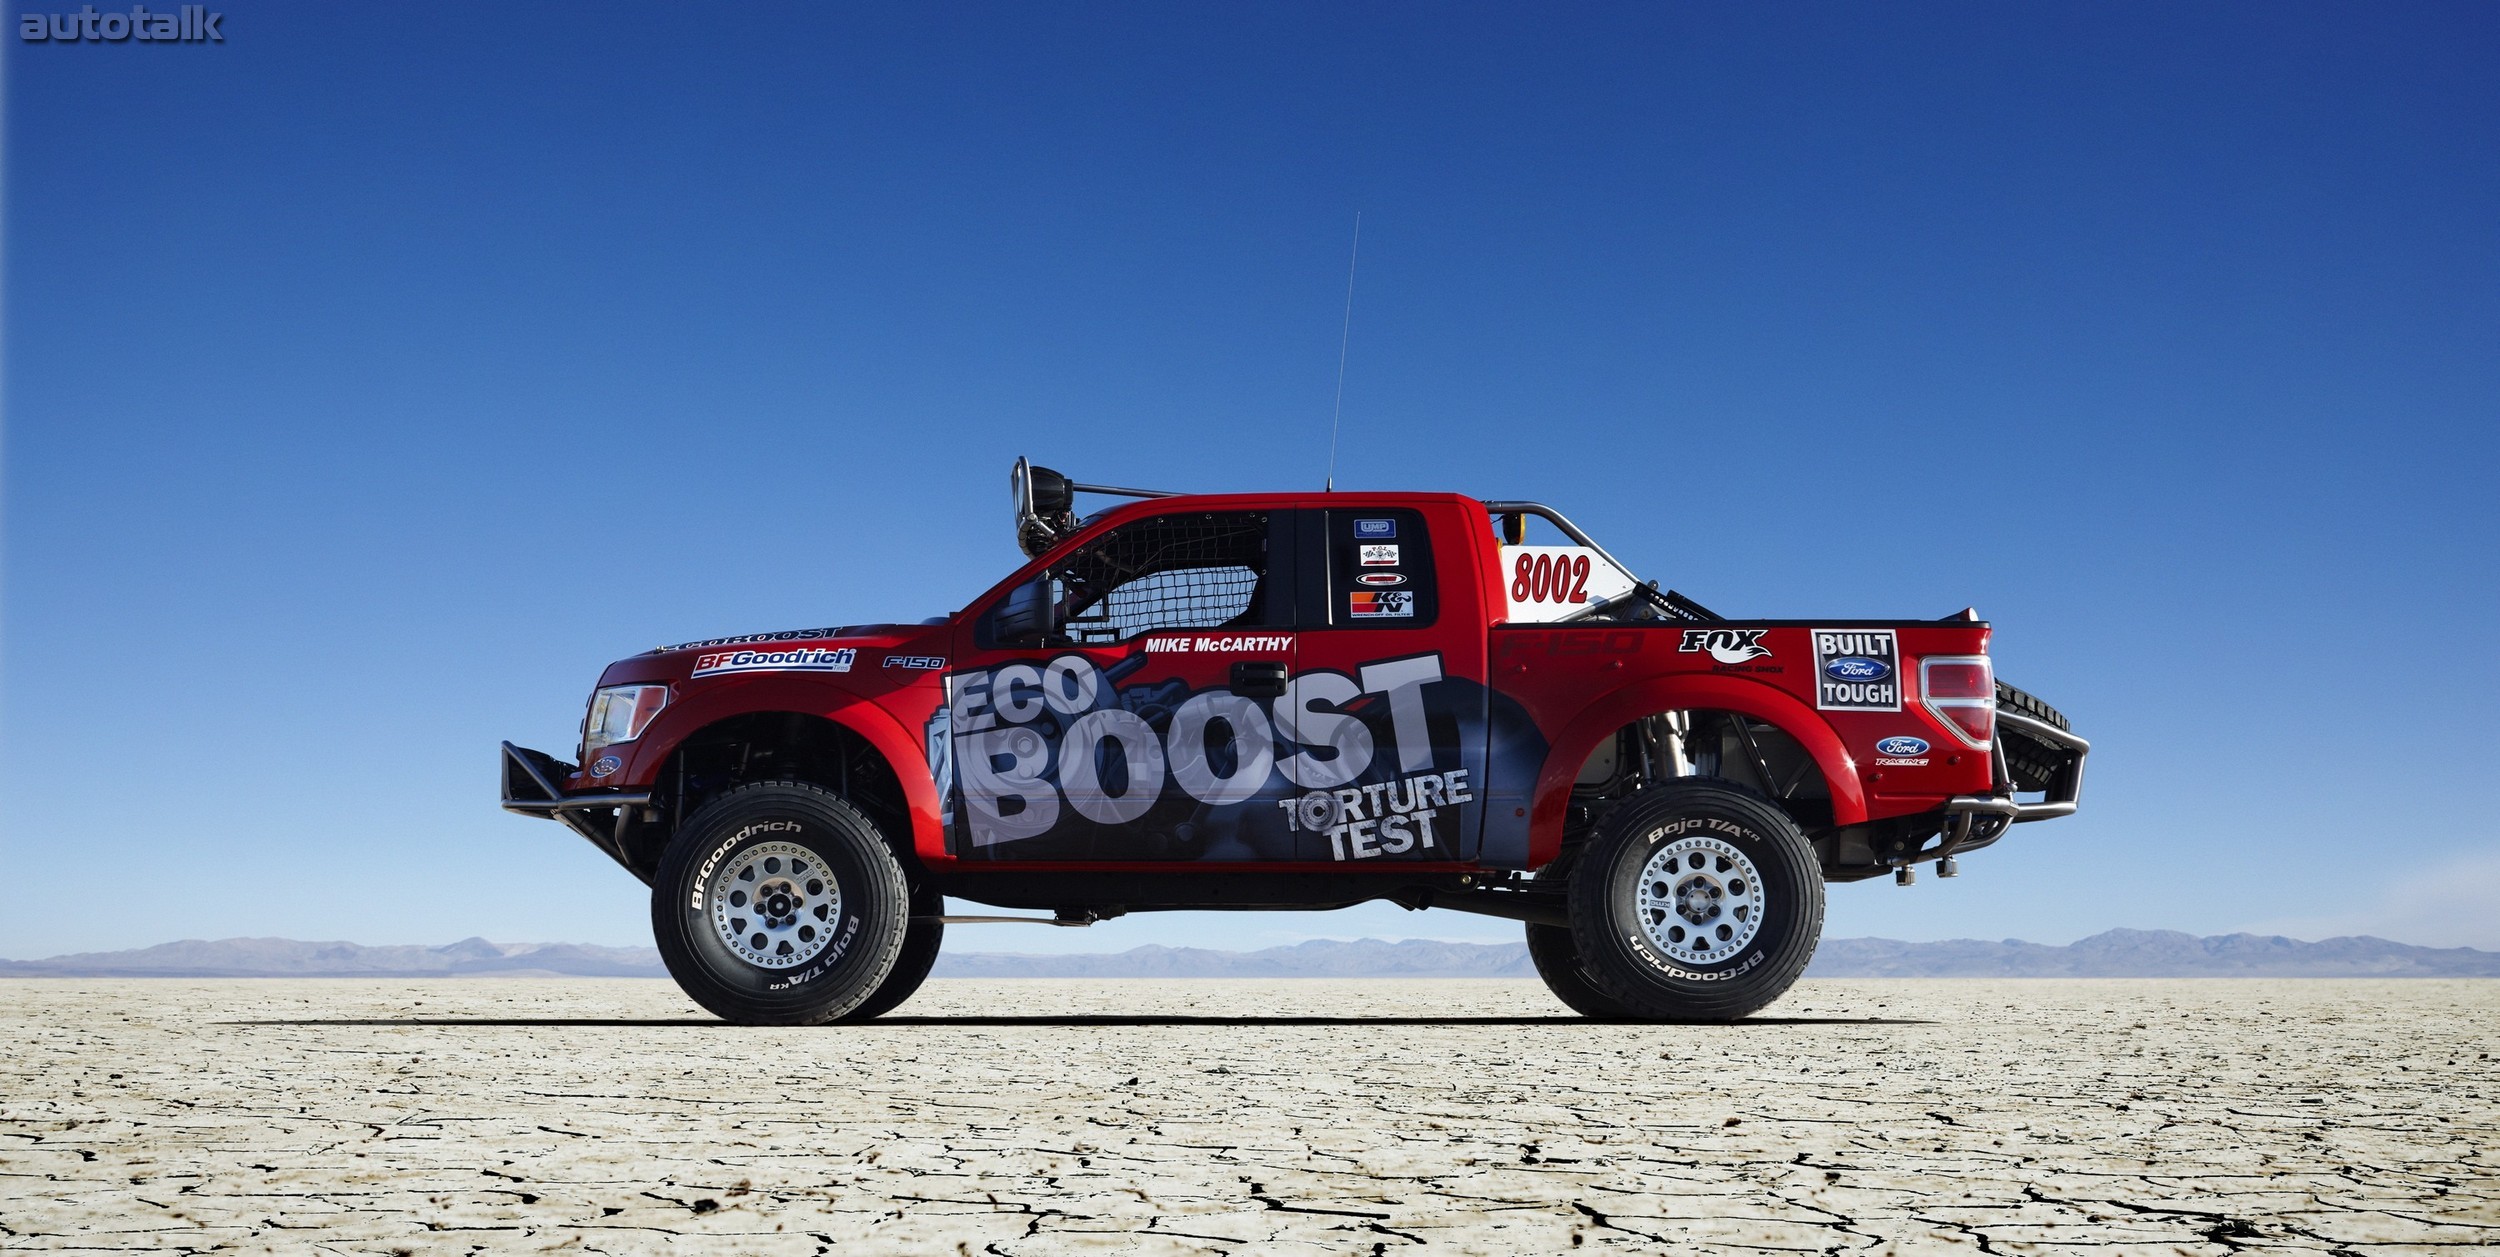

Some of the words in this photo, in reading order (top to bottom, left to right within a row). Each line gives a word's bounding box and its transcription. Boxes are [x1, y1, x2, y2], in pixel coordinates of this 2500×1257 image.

[1362, 522, 1388, 531] UMP
[1512, 552, 1590, 604] 8002
[1145, 638, 1191, 652] MIKE
[1194, 637, 1293, 652] McCARTHY
[1501, 631, 1646, 656] F-150
[1679, 629, 1770, 656] FOX
[1820, 634, 1891, 655] BUILT
[700, 649, 854, 670] BFGoodrich
[883, 656, 945, 669] F-150
[1712, 665, 1752, 673] RACING
[1841, 662, 1874, 676] Ford
[944, 654, 1098, 734] ECO
[1823, 683, 1894, 703] TOUGH
[954, 654, 1444, 848] BOOST
[1886, 739, 1919, 754] Ford
[1876, 758, 1930, 766] RACING
[1278, 768, 1474, 834] TORTURE
[1323, 809, 1439, 862] TEST
[1648, 817, 1703, 845] Baja
[691, 820, 802, 911] BFGoodrich
[824, 914, 860, 967] Baja
[1629, 935, 1766, 981] BFGoodrich
